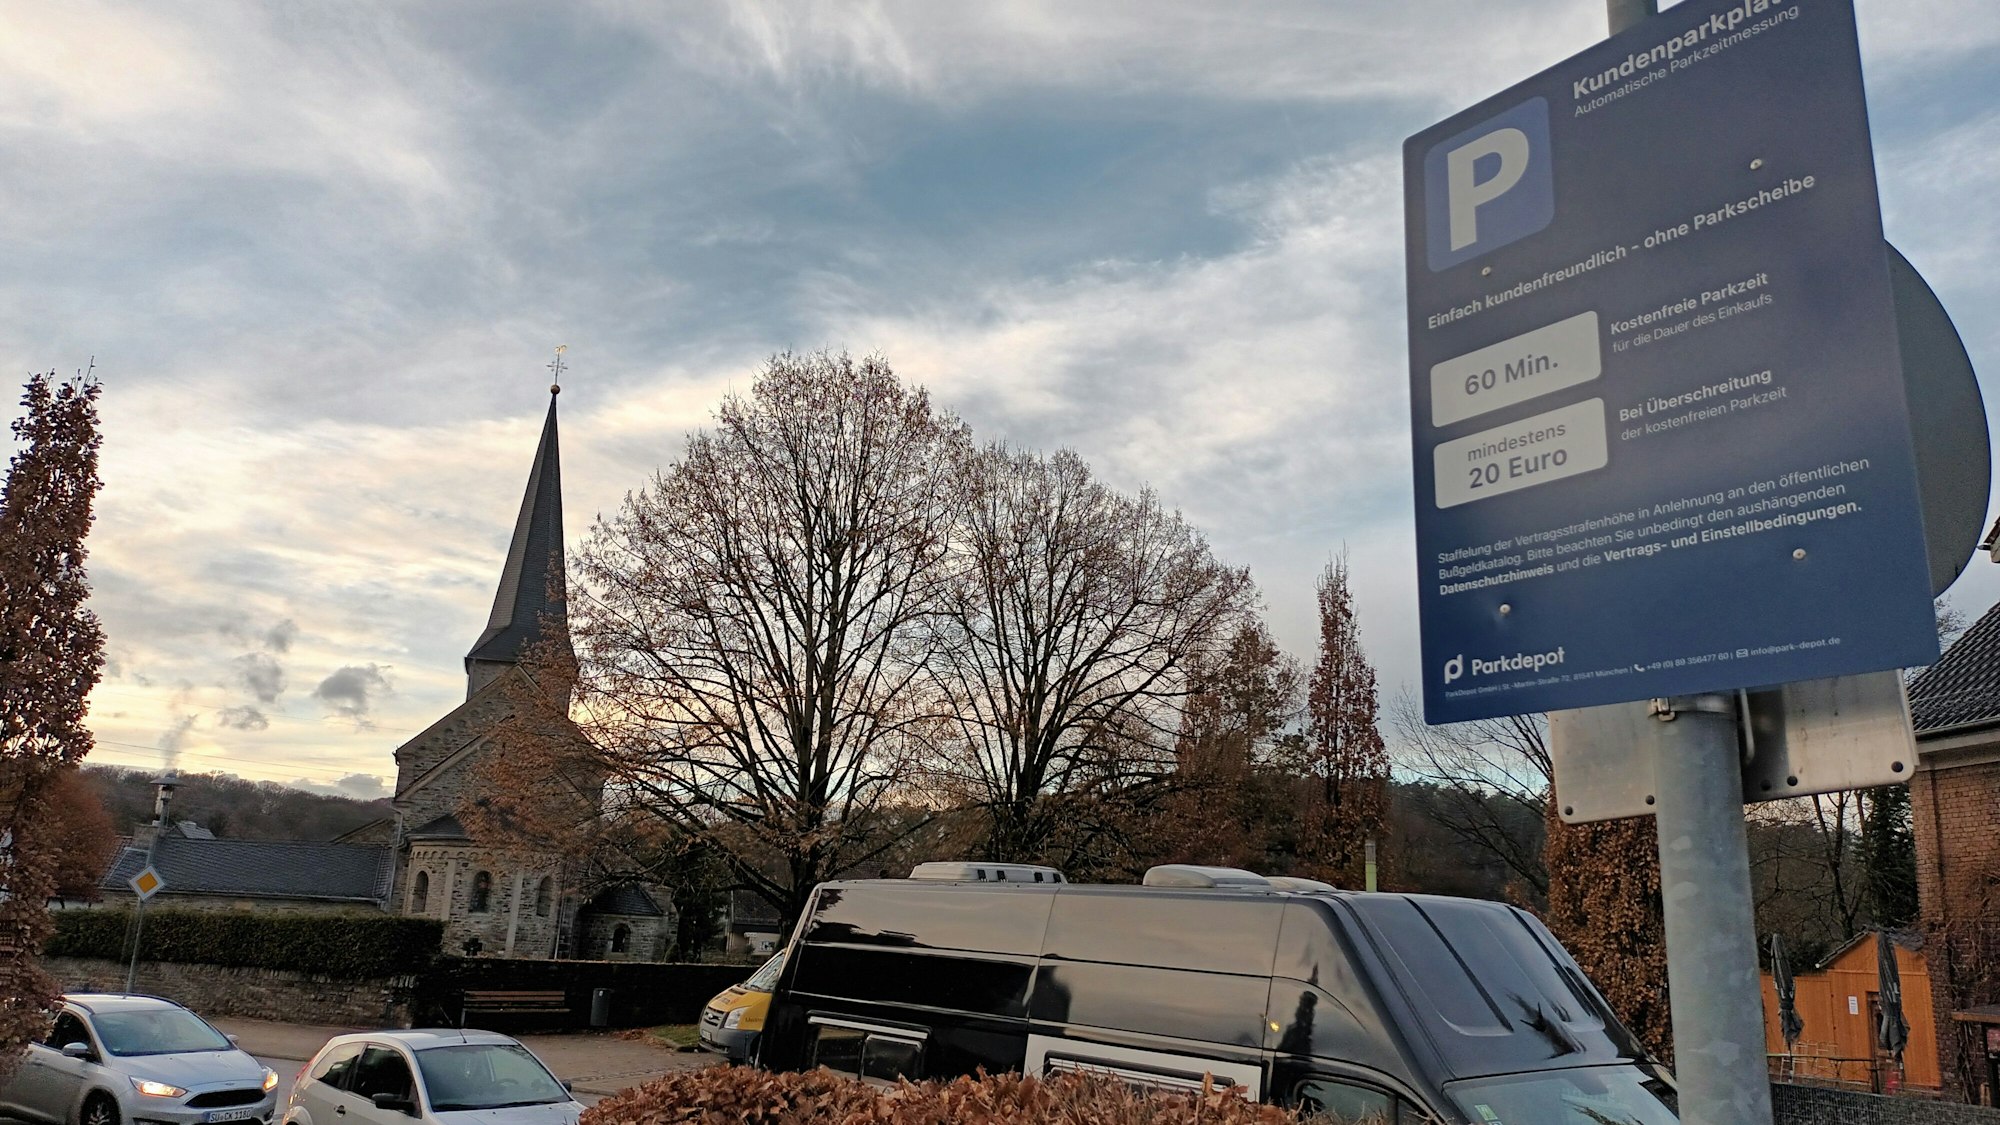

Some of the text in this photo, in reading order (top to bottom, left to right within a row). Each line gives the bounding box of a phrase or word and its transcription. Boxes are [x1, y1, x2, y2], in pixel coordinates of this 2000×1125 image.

[1573, 0, 1783, 99] Kundenparkpla
[1574, 5, 1799, 117] Automatische Parkzeitmessung
[1447, 127, 1530, 252] P
[1427, 294, 1482, 330] Einfach
[1485, 244, 1627, 308] kundenfreundlich
[1643, 222, 1689, 249] ohne
[1694, 174, 1815, 230] Parkscheibe
[1610, 272, 1769, 335] Kostenfreie Parkzeit
[1612, 293, 1773, 353] für die Dauer des Einkaufs
[1464, 354, 1559, 396] 60 Min.
[1619, 370, 1772, 422] Bei Überschreitung
[1467, 424, 1566, 462] mindestens
[1621, 386, 1787, 441] der kostenfreien Parkzeit
[1469, 449, 1568, 489] 20 Euro
[1437, 458, 1870, 564] Staffelung der Vertragsstrafenhöhe in Anlehnung an den öffentlichen
[1438, 484, 1846, 580] Bußgeldkatalog. Bitte beachten Sie unbedingt den aushängenden
[1439, 502, 1862, 596] Datenschutzhinweis und die Vertrags- und Einstellbedingungen.
[1471, 646, 1566, 676] Parkdepot
[1595, 667, 1629, 678] München
[1750, 636, 1841, 656] info@park-depot.de
